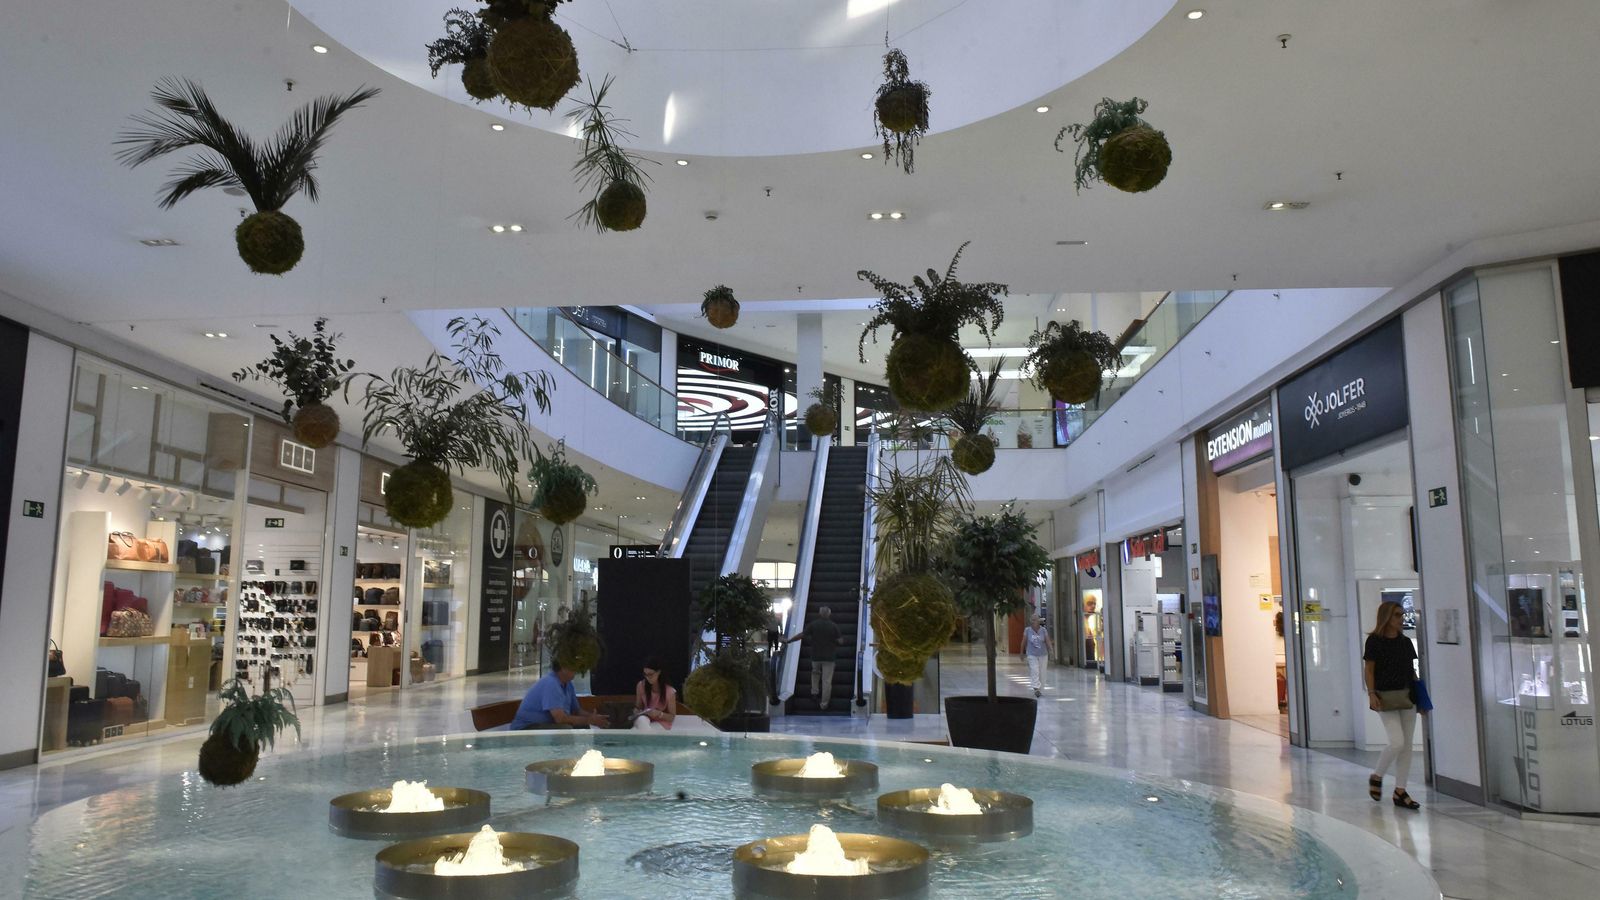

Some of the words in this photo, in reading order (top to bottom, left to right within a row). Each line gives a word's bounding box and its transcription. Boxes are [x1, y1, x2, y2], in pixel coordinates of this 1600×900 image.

[700, 351, 740, 371] PRIMOR
[1324, 377, 1366, 413] JOLFER
[1207, 420, 1253, 461] EXTENSION
[1560, 718, 1593, 726] LOTUS
[1524, 711, 1541, 809] LOTUS
